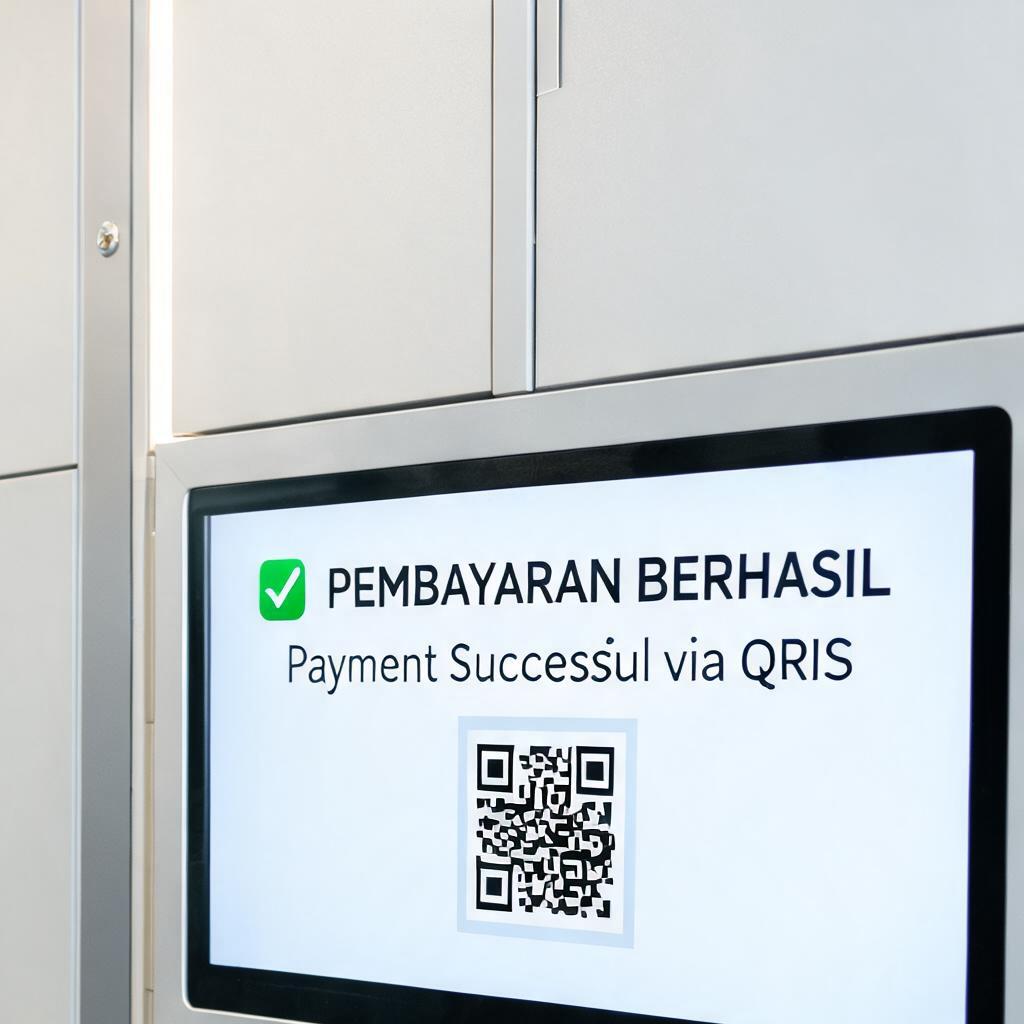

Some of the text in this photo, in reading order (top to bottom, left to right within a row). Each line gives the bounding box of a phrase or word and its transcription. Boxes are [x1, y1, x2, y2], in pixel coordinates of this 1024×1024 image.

[328, 547, 891, 609] PEMBAYARAN BERHASIL
[288, 644, 438, 695] Payment
[663, 636, 724, 682] via
[741, 637, 853, 690] QRIS
